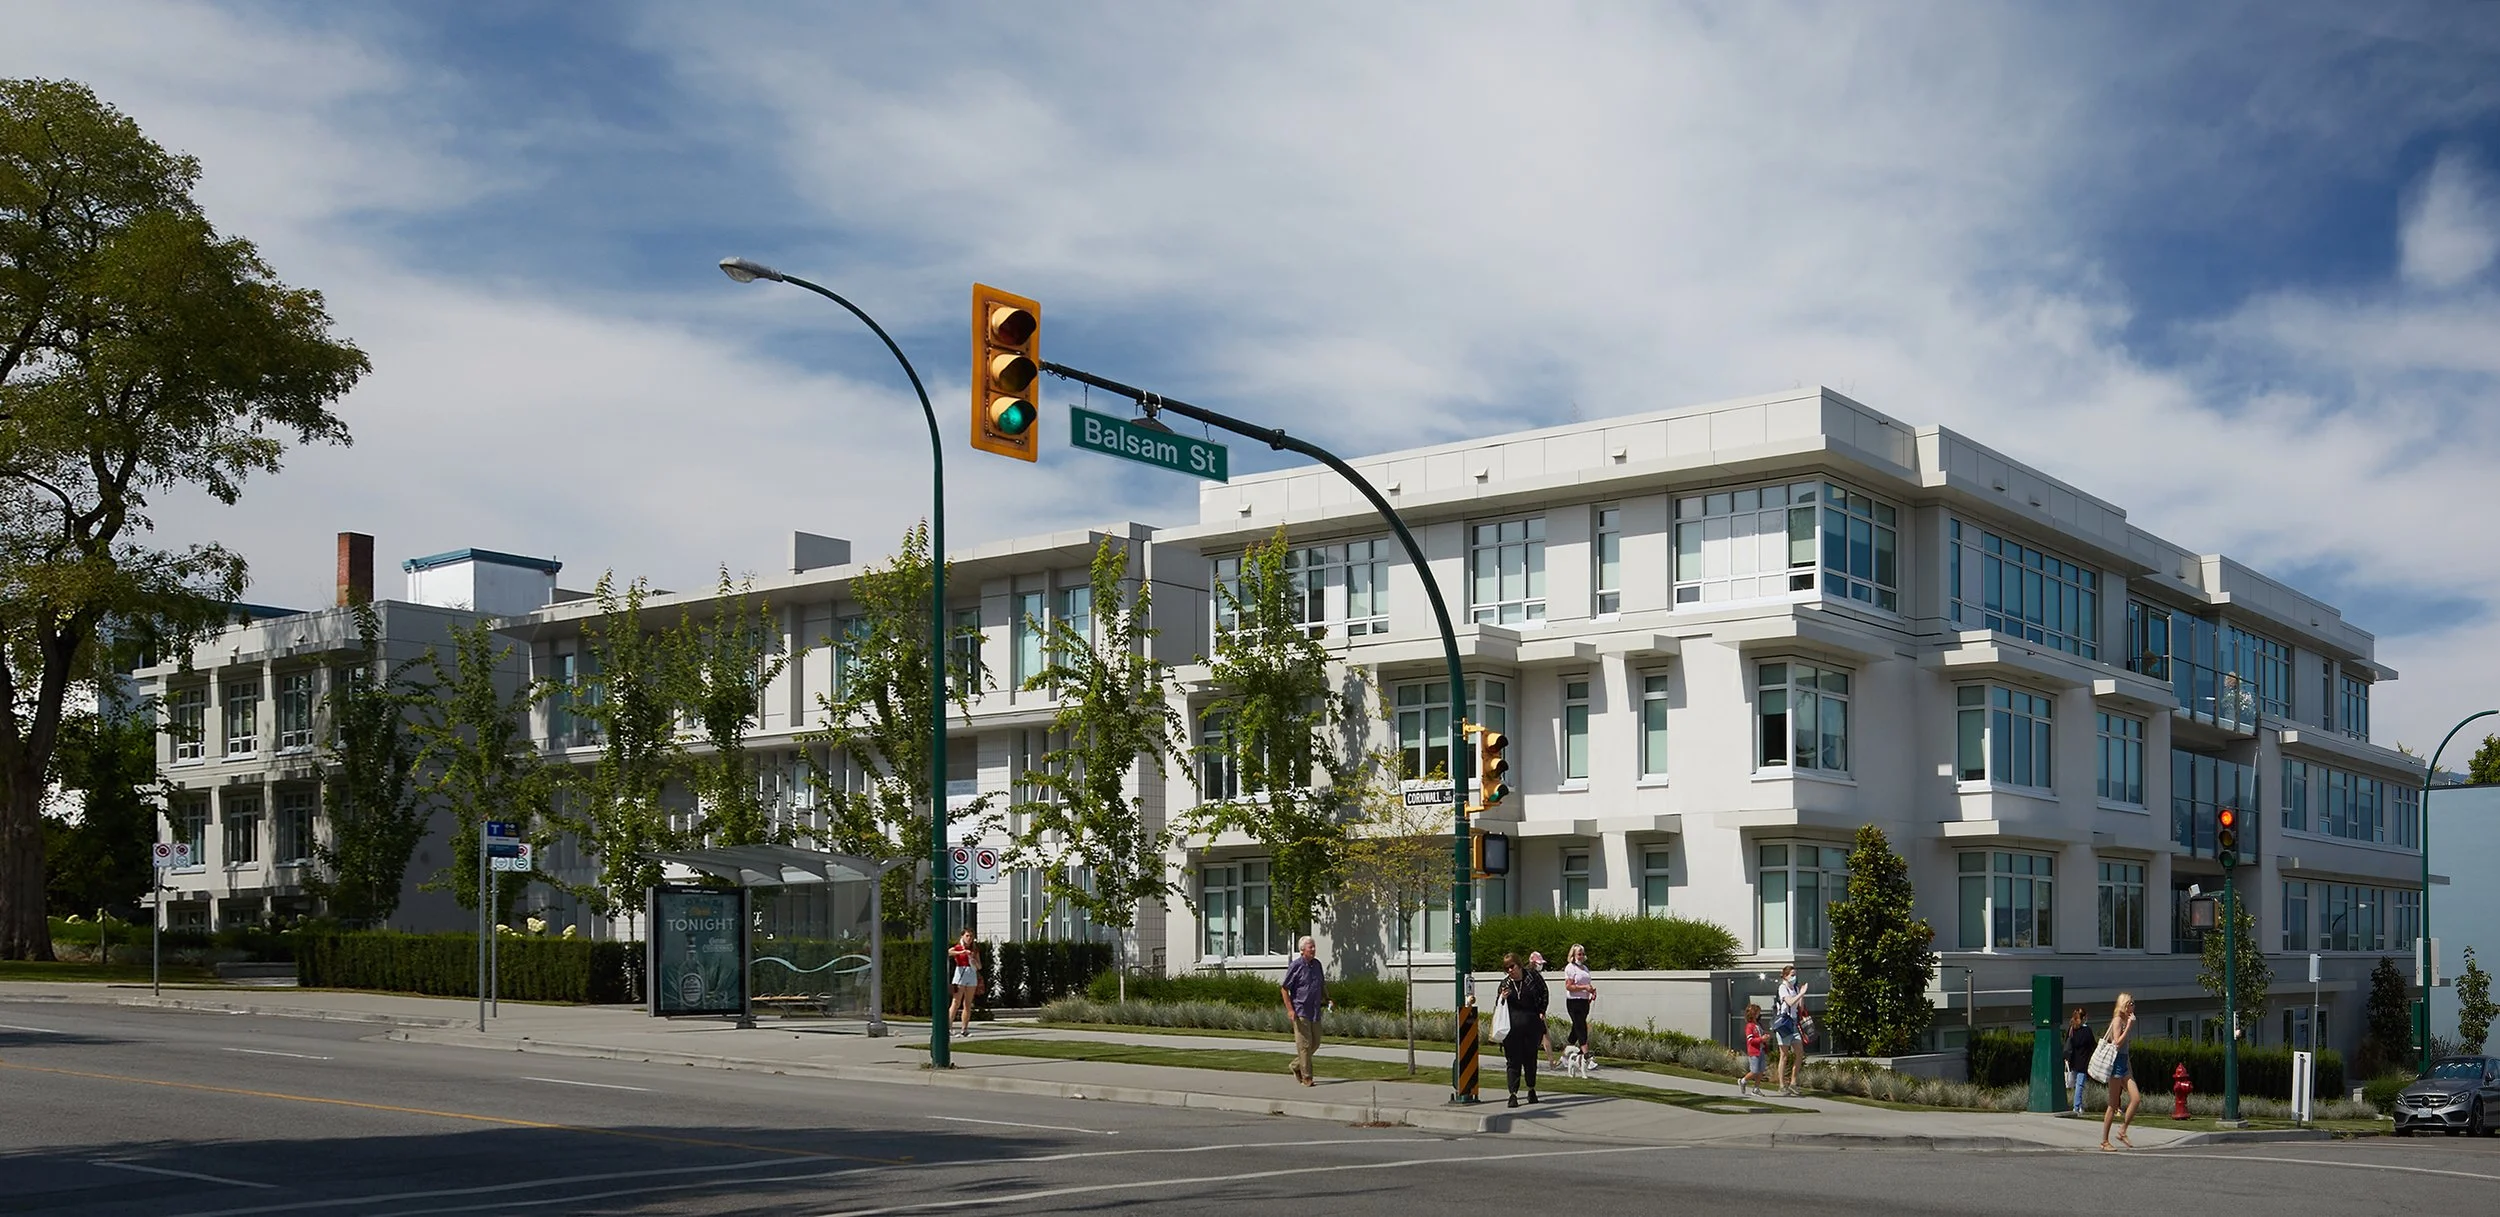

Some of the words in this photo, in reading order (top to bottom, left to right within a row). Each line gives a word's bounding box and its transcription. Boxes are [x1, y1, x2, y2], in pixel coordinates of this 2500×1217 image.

[1084, 417, 1178, 465] Balsam
[1189, 444, 1216, 474] St
[1407, 791, 1441, 804] CORNWALL
[490, 824, 500, 835] T
[666, 918, 735, 932] TONIGHT
